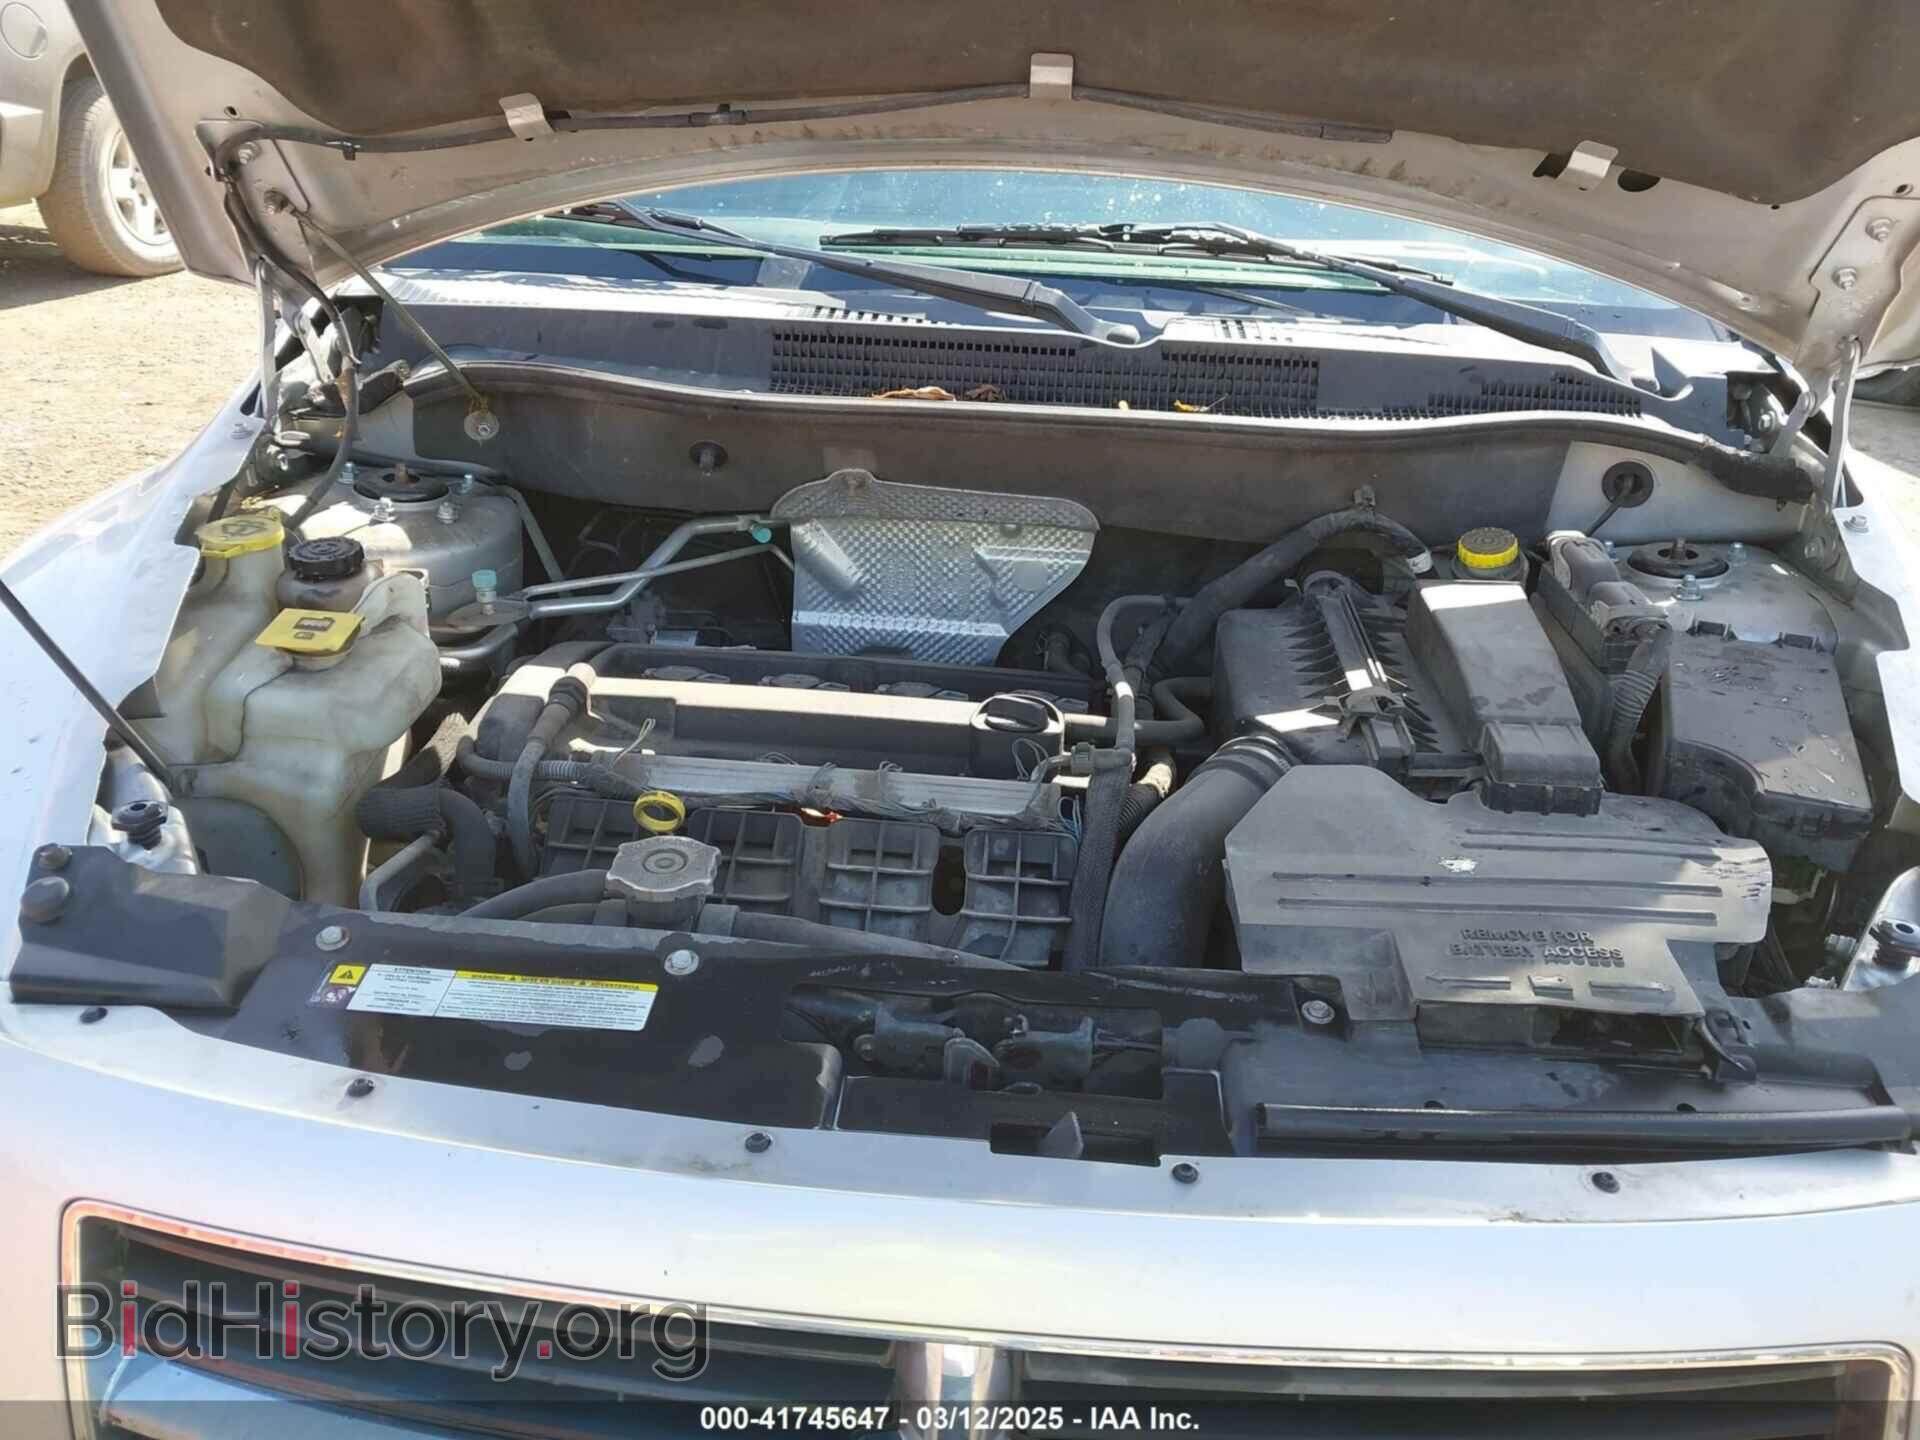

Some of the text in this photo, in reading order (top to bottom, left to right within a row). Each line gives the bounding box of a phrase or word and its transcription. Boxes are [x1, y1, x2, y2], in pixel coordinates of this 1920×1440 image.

[1460, 928, 1594, 944] REMOVE FOR
[1449, 943, 1625, 961] BATTERY ACCESS
